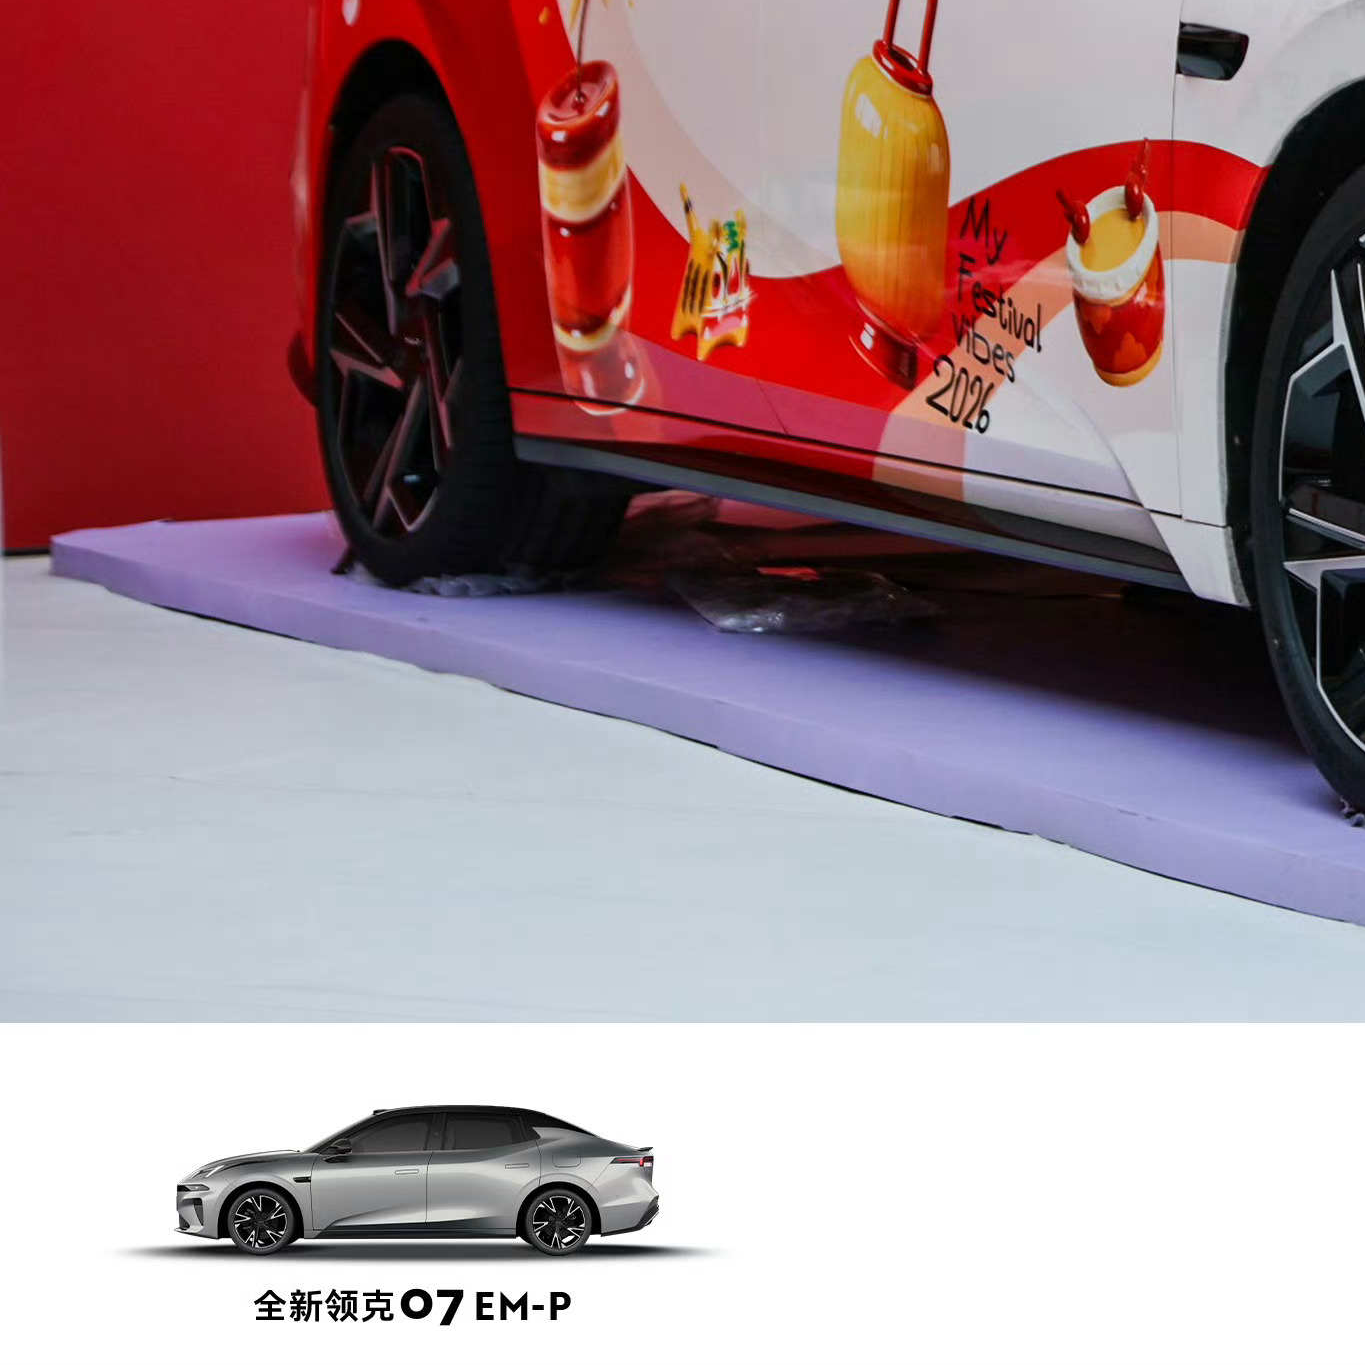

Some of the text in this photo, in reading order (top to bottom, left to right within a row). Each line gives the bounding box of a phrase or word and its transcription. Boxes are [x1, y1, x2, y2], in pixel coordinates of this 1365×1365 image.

[960, 196, 1008, 265] My
[958, 252, 1042, 353] Festival
[926, 354, 995, 434] 2026
